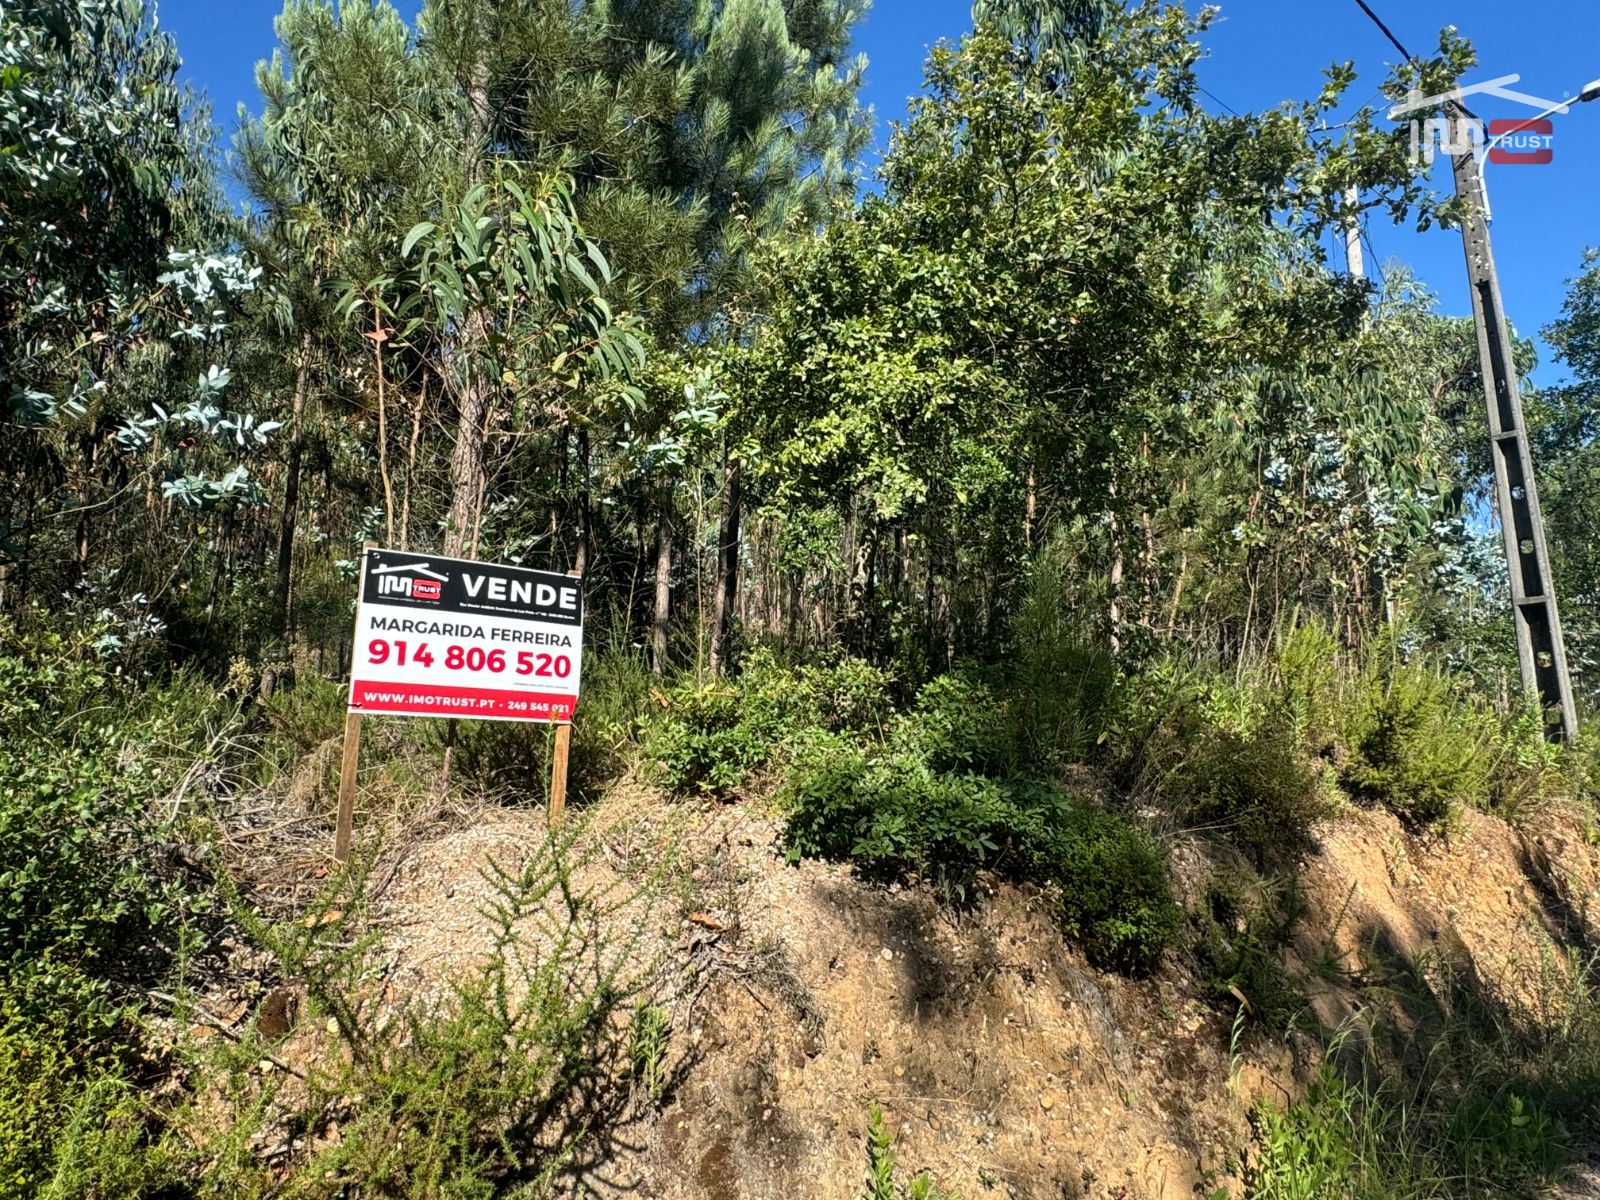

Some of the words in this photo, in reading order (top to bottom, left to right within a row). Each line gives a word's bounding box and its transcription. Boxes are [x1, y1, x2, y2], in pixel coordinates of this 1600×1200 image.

[413, 585, 441, 593] TRUST
[461, 573, 577, 610] VENDE
[370, 616, 485, 639] MARGARIDA
[491, 628, 572, 648] FERREIRA
[368, 639, 435, 668] 914
[444, 645, 506, 673] 806
[515, 651, 572, 678] 520
[364, 692, 496, 709] WWW.IMOTRUST.PT
[507, 701, 528, 710] 249
[530, 703, 549, 711] 545
[552, 704, 569, 713] 021
